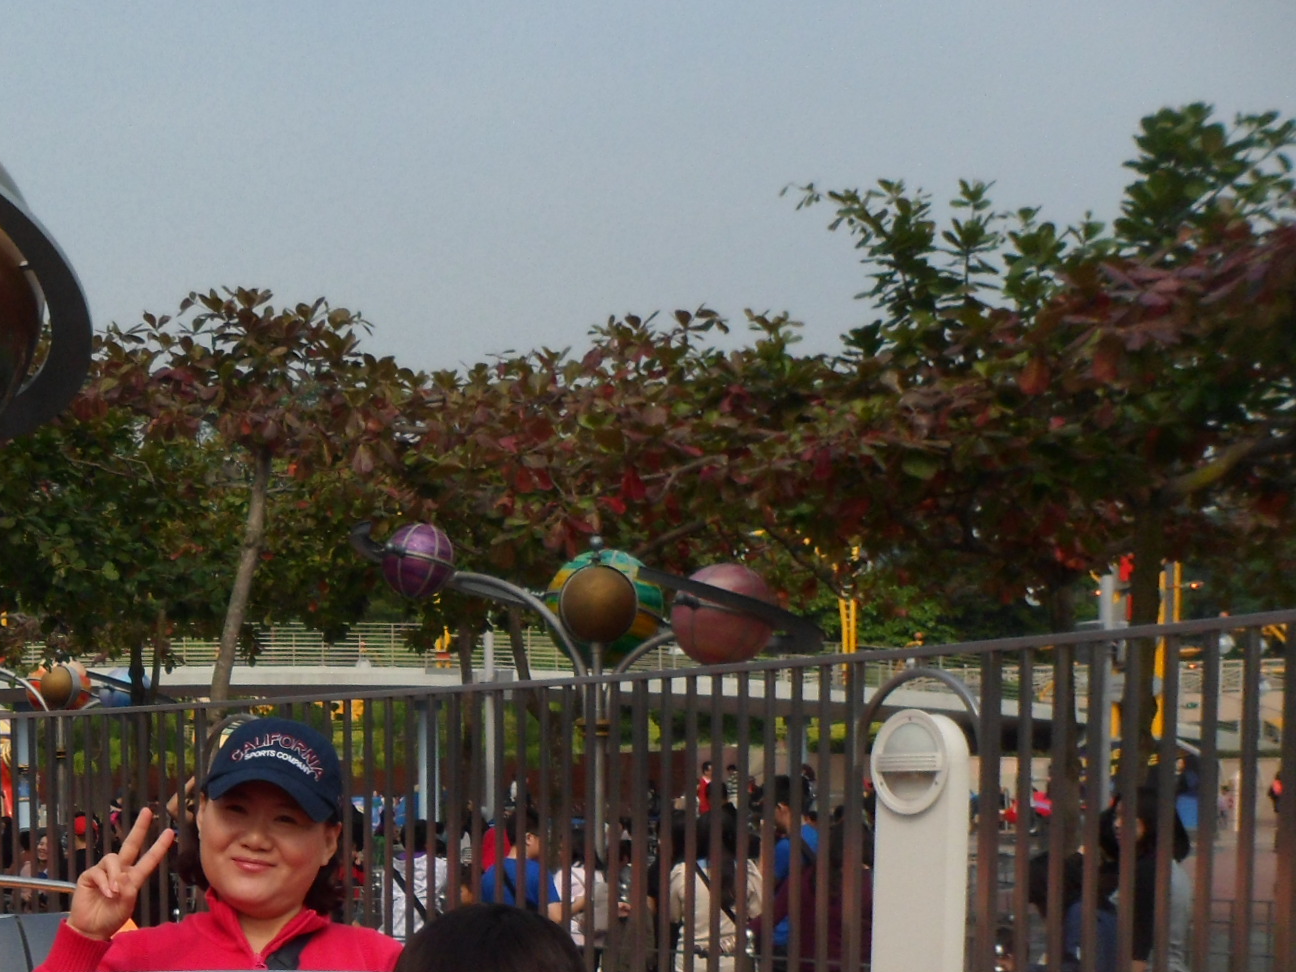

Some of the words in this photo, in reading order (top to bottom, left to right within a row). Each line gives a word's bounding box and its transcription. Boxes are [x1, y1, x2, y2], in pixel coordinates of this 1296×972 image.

[230, 732, 326, 782] CALIFORNIA
[244, 749, 276, 761] SPORTS
[276, 751, 314, 775] COMPANY
